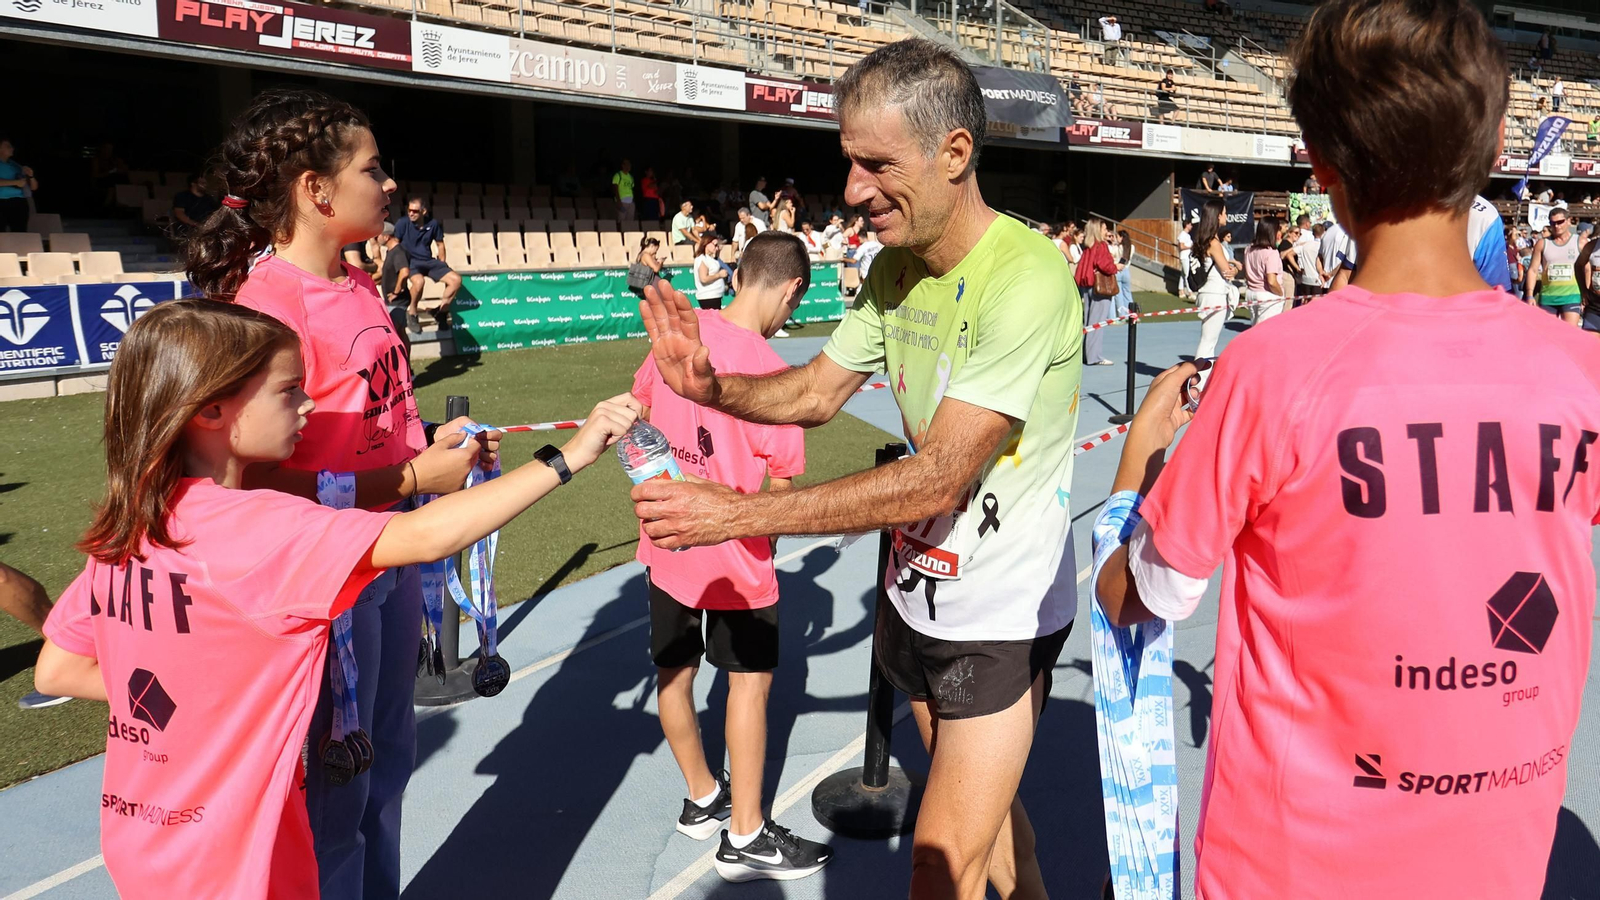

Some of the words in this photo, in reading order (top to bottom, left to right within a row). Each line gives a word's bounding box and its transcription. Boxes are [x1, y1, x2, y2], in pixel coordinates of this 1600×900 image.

[175, 0, 275, 33] PLAY
[446, 45, 502, 60] Ayuntamiento
[446, 53, 457, 61] de
[458, 55, 479, 65] Jerez
[616, 65, 627, 89] SIN
[700, 81, 740, 91] Ayuntamiento
[752, 85, 799, 103] PLAY
[669, 441, 706, 467] ndeso
[1336, 421, 1599, 519] STAFF
[1394, 655, 1518, 691] indeso
[1502, 684, 1540, 707] group
[143, 750, 169, 764] group
[1397, 745, 1566, 796] SPORTMADNESS
[102, 793, 206, 827] SPORTMADNESS
